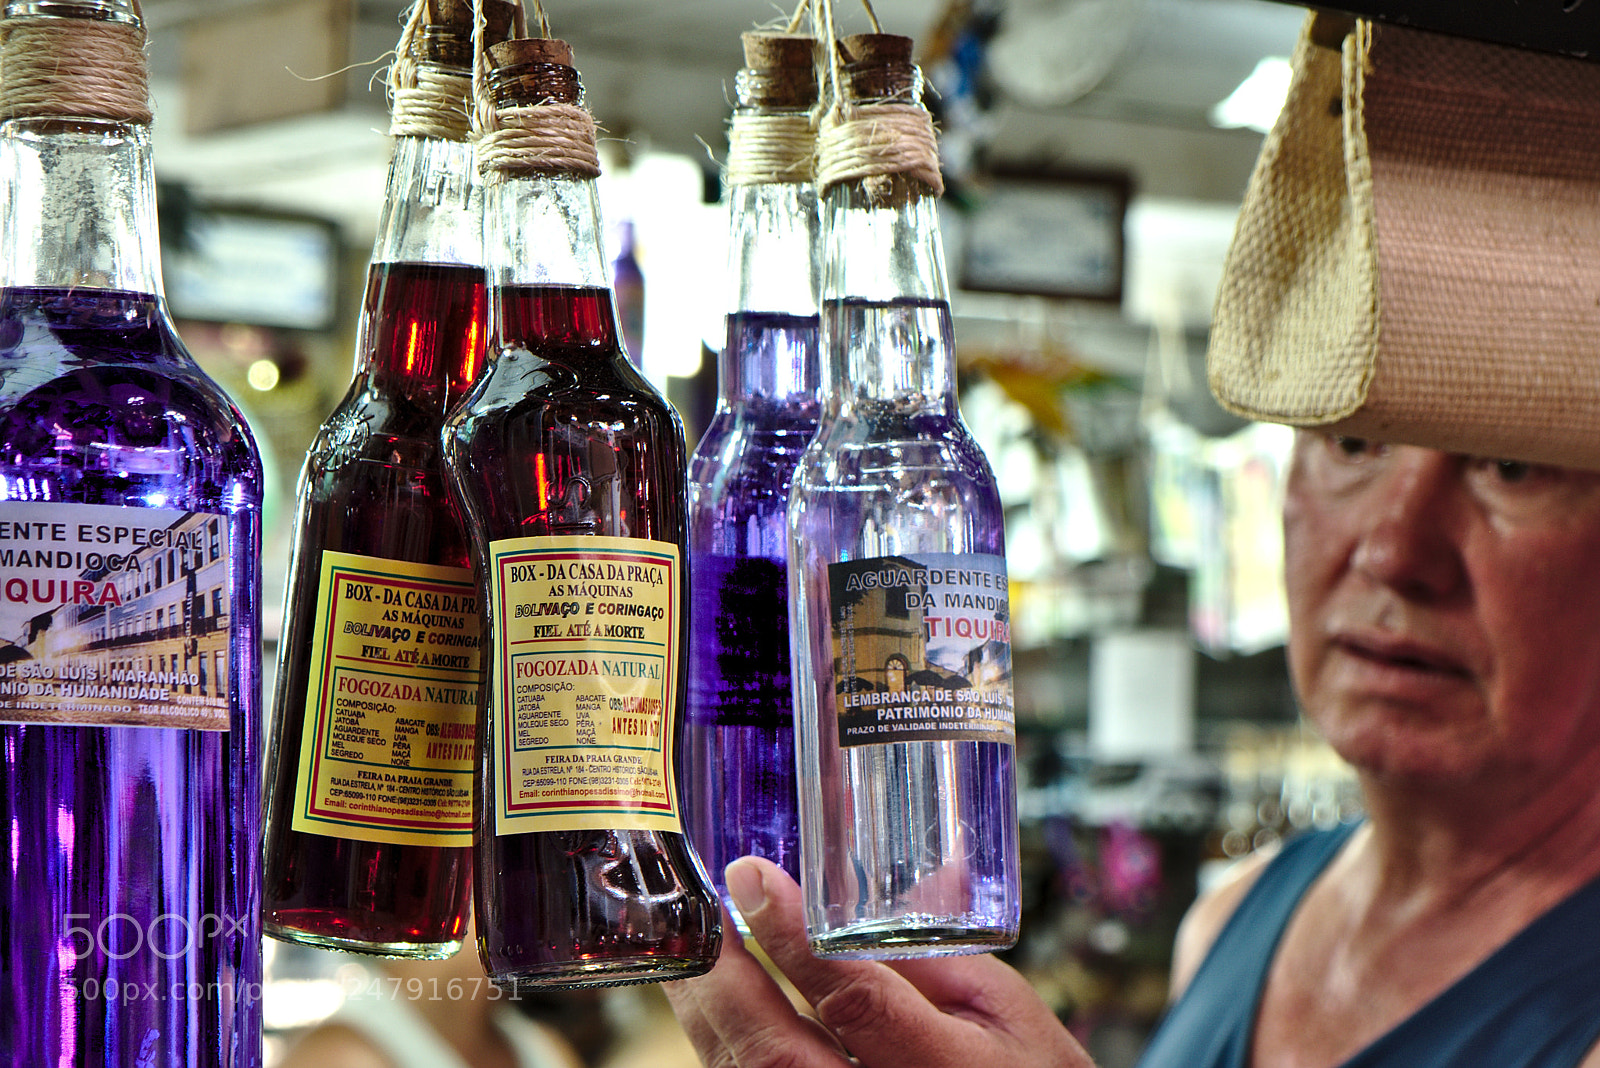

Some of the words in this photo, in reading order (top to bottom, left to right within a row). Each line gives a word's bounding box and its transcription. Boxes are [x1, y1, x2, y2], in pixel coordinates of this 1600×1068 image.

[78, 524, 203, 550] ESPECIAL
[0, 549, 142, 572] MANDIOCA
[510, 564, 536, 583] BOX
[547, 563, 566, 581] DA
[568, 562, 604, 580] CASA
[607, 564, 625, 581] DA
[627, 565, 664, 587] PRAÇA
[846, 569, 992, 591] AGUARDENTE
[0, 577, 122, 607] QUIRA
[548, 585, 565, 597] AS
[567, 581, 633, 598] MÁQUINAS
[345, 583, 374, 602] BOX
[382, 587, 402, 606] DA
[405, 590, 440, 612] CASA
[442, 595, 459, 613] DA
[905, 592, 936, 610] DA
[382, 609, 398, 622] AS
[401, 609, 465, 629] MÁQUINAS
[515, 602, 580, 618] BOLIVAÇO
[585, 603, 594, 615] E
[598, 603, 664, 621] CORINGAÇO
[344, 620, 411, 643] BOLIVAÇO
[416, 631, 426, 643] E
[533, 624, 562, 638] FIEL
[566, 620, 592, 637] ATÉ
[593, 626, 602, 637] A
[604, 625, 645, 639] MORTE
[923, 617, 1010, 643] TIQUIRA
[361, 645, 390, 660] FIEL
[394, 648, 419, 664] ATÉ
[420, 652, 429, 664] A
[431, 653, 470, 668] MORTE
[21, 663, 55, 680] SÃO
[60, 664, 98, 681] LUÍS
[112, 668, 200, 687] MARANHÃO
[516, 659, 599, 679] FOGOZADA
[601, 660, 661, 680] NATURAL
[34, 683, 57, 697] DA
[60, 684, 170, 702] HUMANIDADE
[338, 676, 422, 702] FOGOZADA
[516, 682, 575, 694] COMPOSIÇÃO:
[336, 698, 397, 714] COMPOSIÇÃO:
[517, 694, 546, 704] CATUABA
[844, 690, 931, 708] LEMBRANÇA
[934, 690, 953, 702] DE
[956, 688, 980, 703] SÃO
[982, 690, 1003, 705] LUÍS
[16, 701, 132, 713] INDETERMINADO
[335, 708, 366, 719] CATUABA
[576, 703, 601, 711] MANGA
[877, 702, 964, 721] PATRIMÔNIO
[967, 706, 982, 719] DA
[395, 718, 425, 728] ABACATE
[518, 711, 562, 721] AGUARDENTE
[518, 720, 549, 729] MOLEQUE
[550, 719, 569, 727] SECO
[333, 725, 380, 737] AGUARDENTE
[394, 726, 419, 735] MANGA
[426, 723, 440, 737] OBS:
[518, 729, 531, 738] MEL
[612, 717, 638, 735] ANTES
[847, 725, 875, 735] PRAZO
[877, 724, 889, 733] DE
[892, 721, 937, 732] VALIDADE
[331, 740, 345, 749] MEL
[332, 733, 366, 744] MOLEQUE
[366, 736, 387, 746] SECO
[394, 734, 408, 742] UVA
[518, 737, 549, 746] SEGREDO
[331, 748, 364, 759] SEGREDO
[426, 742, 453, 760] ANTES
[390, 758, 410, 767] NONE
[545, 755, 571, 764] FEIRA
[572, 755, 584, 763] DA
[586, 755, 612, 763] PRAIA
[613, 755, 643, 764] GRANDE
[357, 770, 383, 781] FEIRA
[384, 774, 397, 783] DA
[397, 775, 423, 786] PRAIA
[424, 777, 453, 787] GRANDE
[522, 768, 533, 776] RUA
[532, 767, 539, 775] DA
[575, 766, 585, 774] 184
[588, 765, 612, 774] CENTRO
[330, 777, 343, 786] RUA
[342, 778, 350, 786] DA
[398, 785, 420, 796] CENTRO
[519, 790, 540, 799] Email:
[324, 797, 347, 808] Email:
